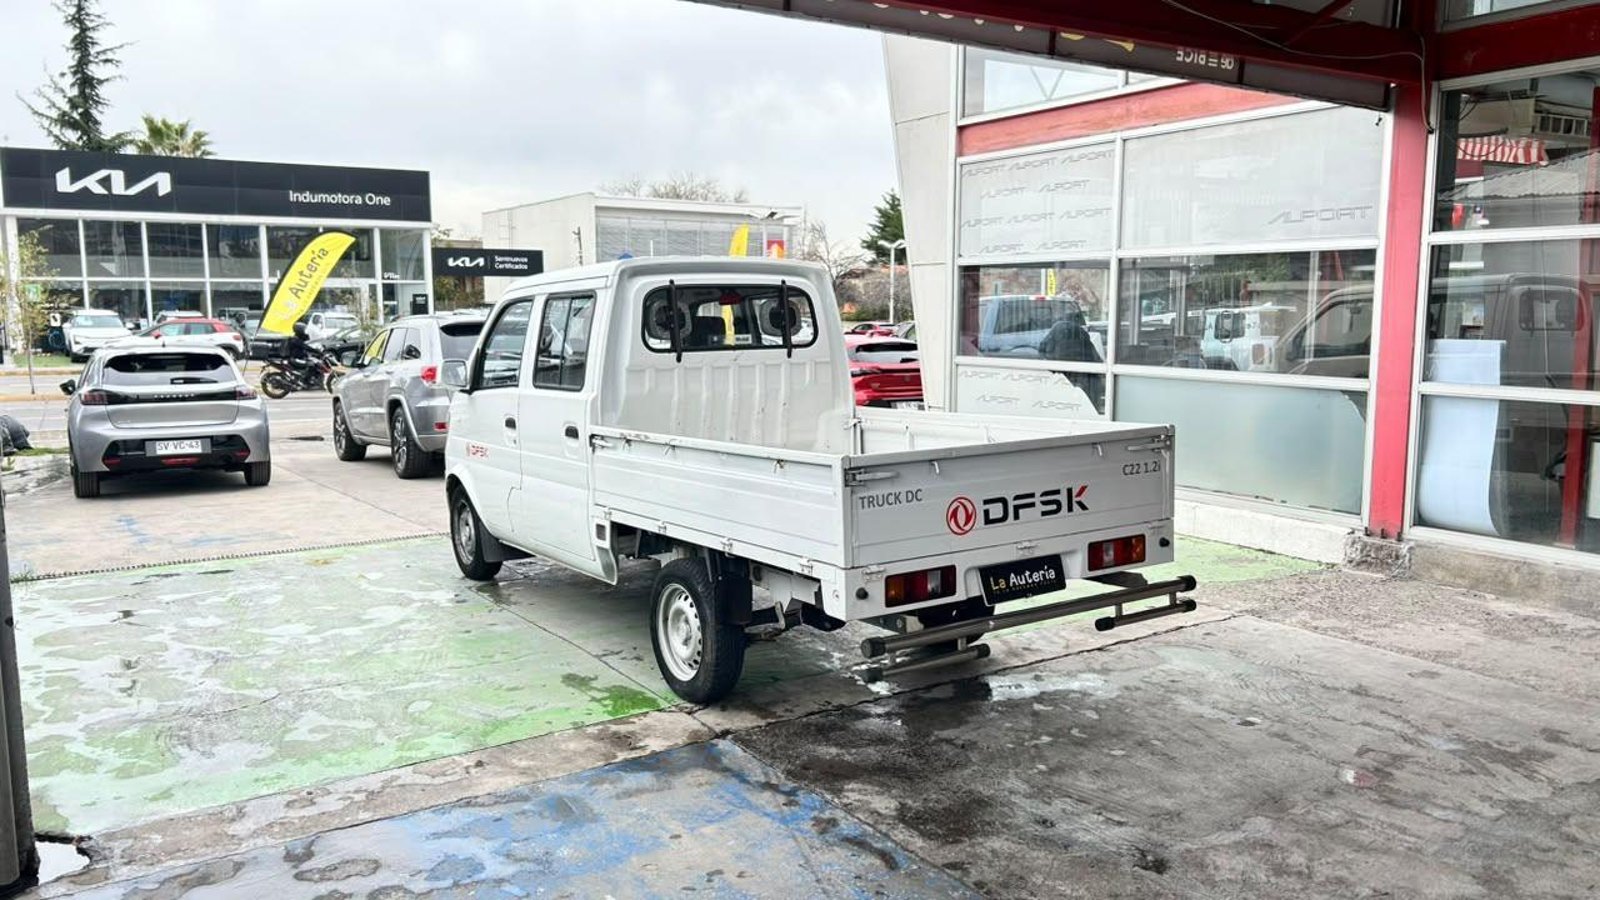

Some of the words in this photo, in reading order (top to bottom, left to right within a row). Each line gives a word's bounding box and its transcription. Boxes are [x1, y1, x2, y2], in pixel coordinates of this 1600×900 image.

[55, 166, 172, 197] KIA
[289, 190, 363, 205] Indumotora
[365, 193, 391, 206] One
[447, 256, 485, 267] KIA
[1122, 463, 1141, 476] C22
[858, 490, 902, 510] TRUCK
[905, 488, 923, 503] DC
[982, 484, 1090, 526] DFSK
[990, 576, 1007, 591] La
[1009, 564, 1056, 588] Autería
